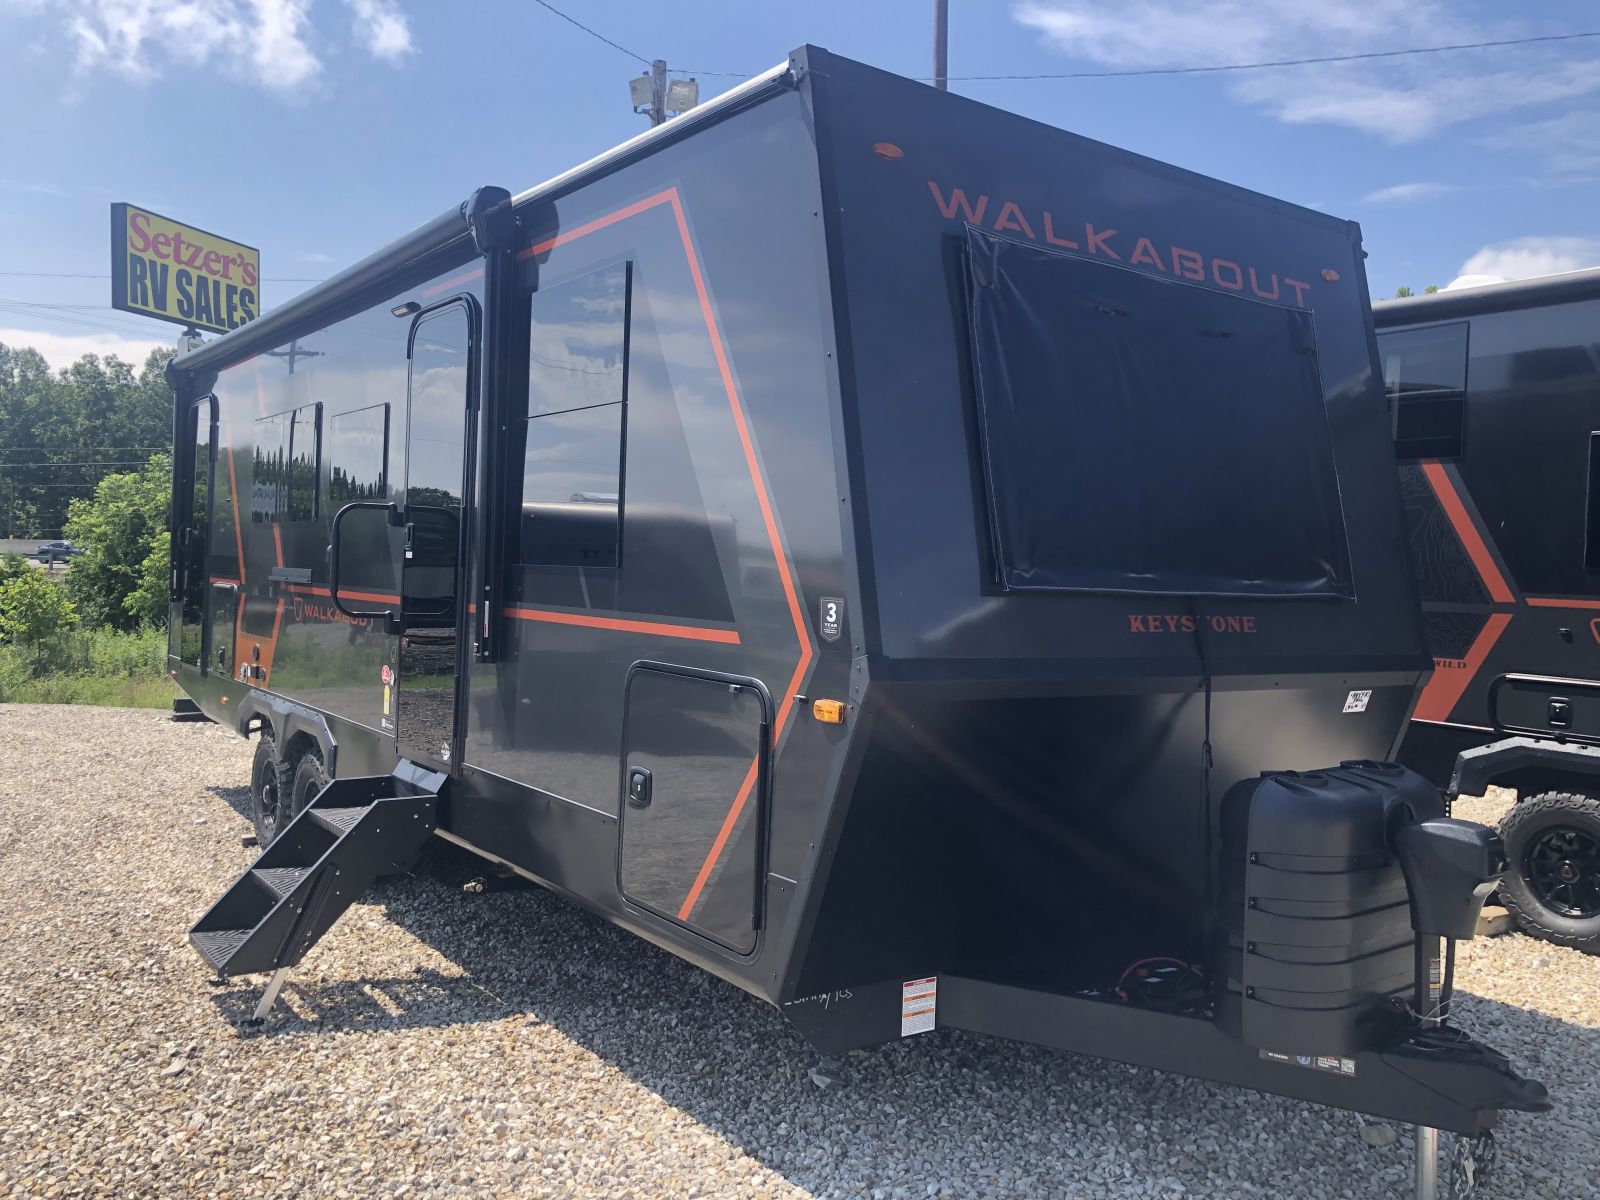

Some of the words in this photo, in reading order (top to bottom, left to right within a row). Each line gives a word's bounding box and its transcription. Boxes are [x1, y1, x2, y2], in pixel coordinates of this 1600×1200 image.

[129, 212, 257, 287] Setzer's
[928, 181, 1311, 307] WALKABOUT
[129, 252, 169, 312] RV
[175, 268, 256, 330] SALES
[826, 602, 837, 623] 3
[1128, 614, 1257, 633] KEYSONE
